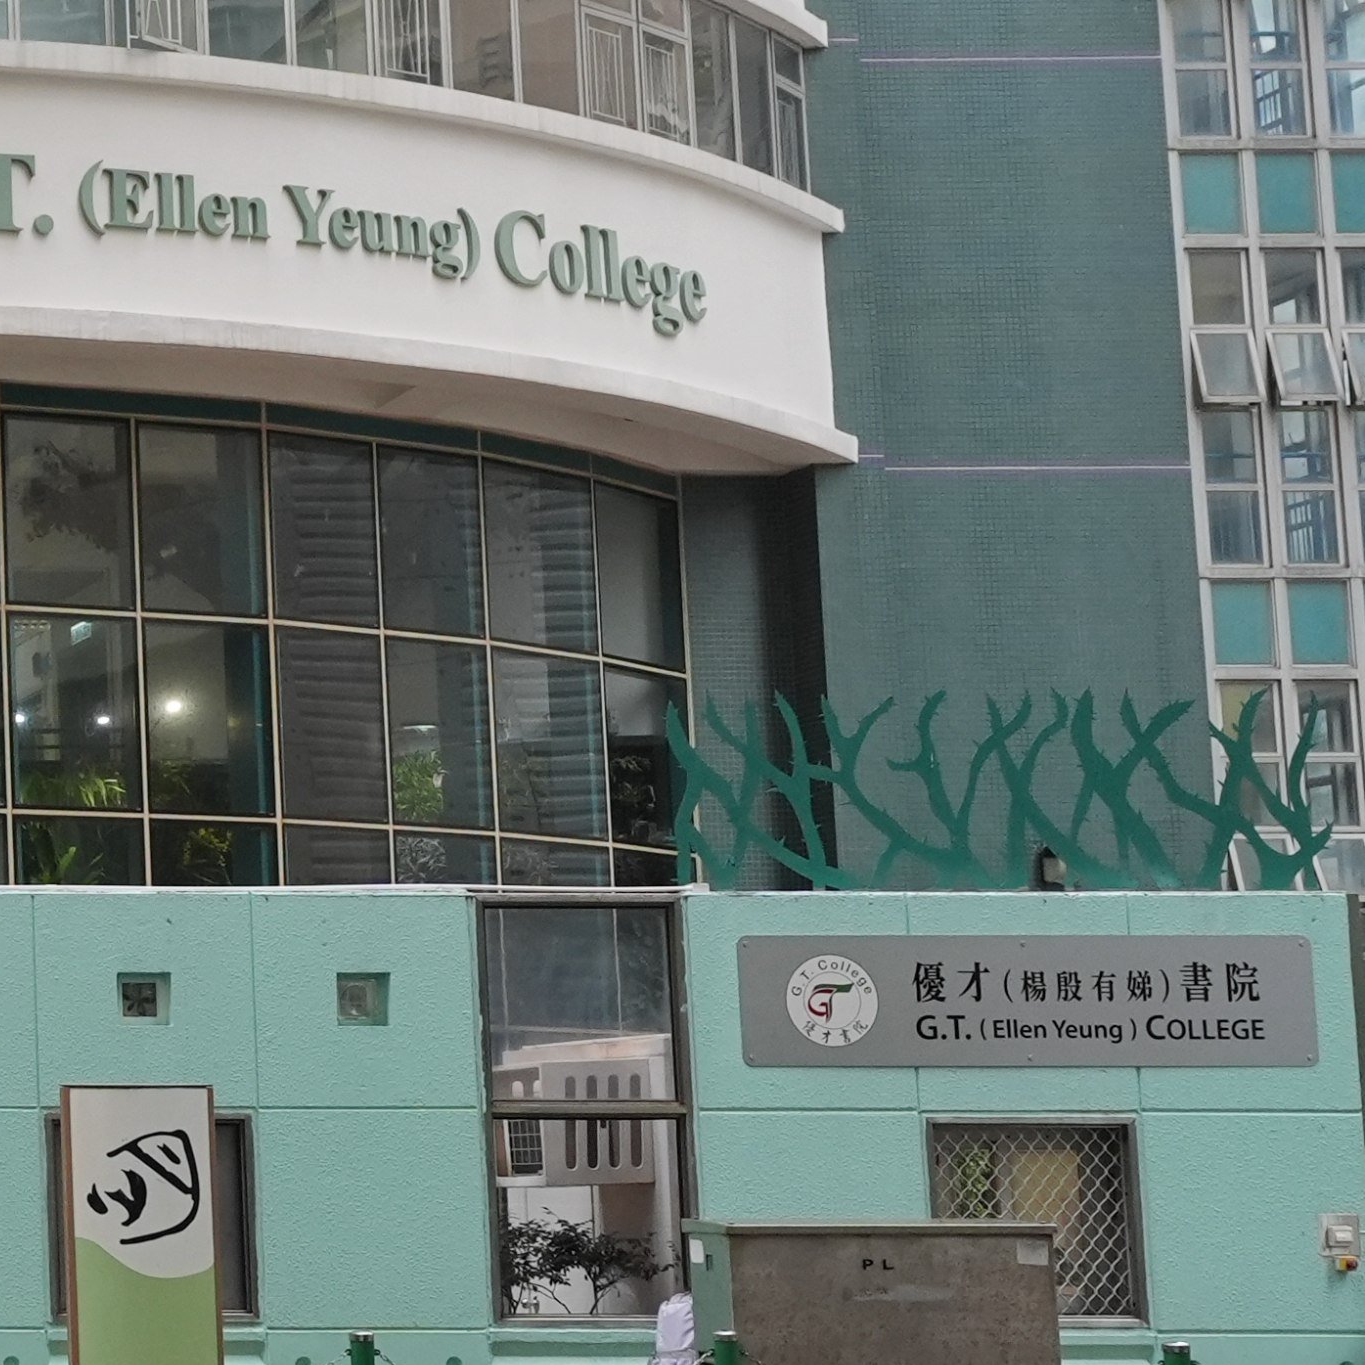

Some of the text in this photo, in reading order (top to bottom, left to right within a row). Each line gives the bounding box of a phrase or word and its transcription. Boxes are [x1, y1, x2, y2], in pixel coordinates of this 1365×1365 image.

[78, 159, 269, 241] (Ellen
[282, 183, 480, 280] Yeung)
[494, 208, 708, 337] College
[817, 959, 873, 995] College
[915, 1014, 973, 1041] G.T.
[1145, 1013, 1266, 1041] COLLEGE
